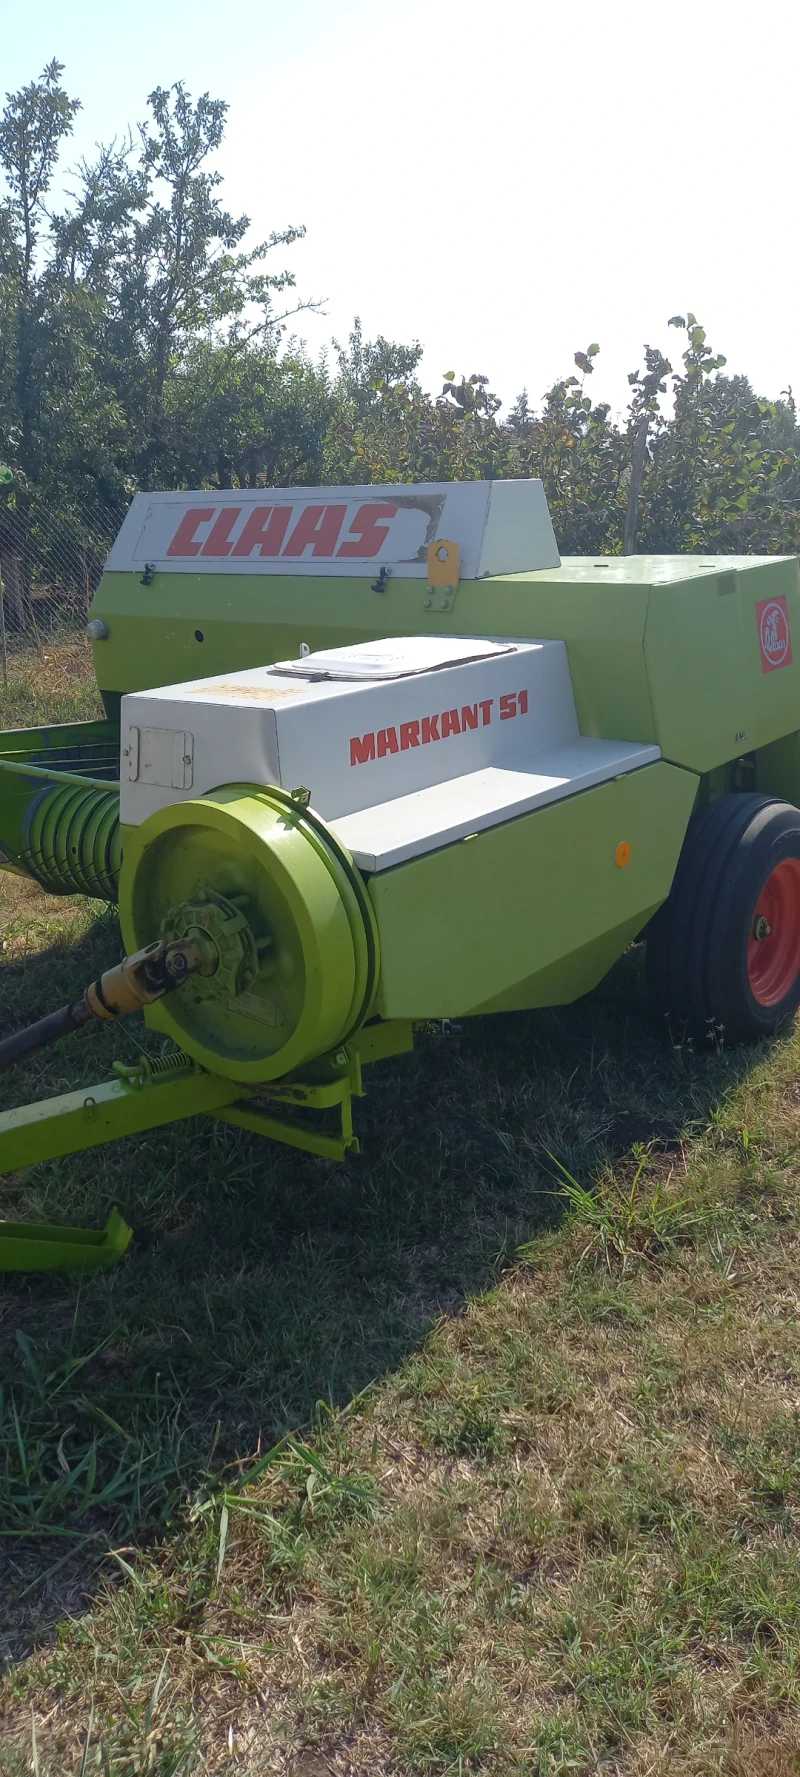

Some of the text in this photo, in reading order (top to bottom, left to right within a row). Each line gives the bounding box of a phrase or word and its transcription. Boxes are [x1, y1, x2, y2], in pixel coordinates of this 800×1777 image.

[166, 503, 399, 558] CLAAS
[350, 689, 529, 767] MARKANT 51
